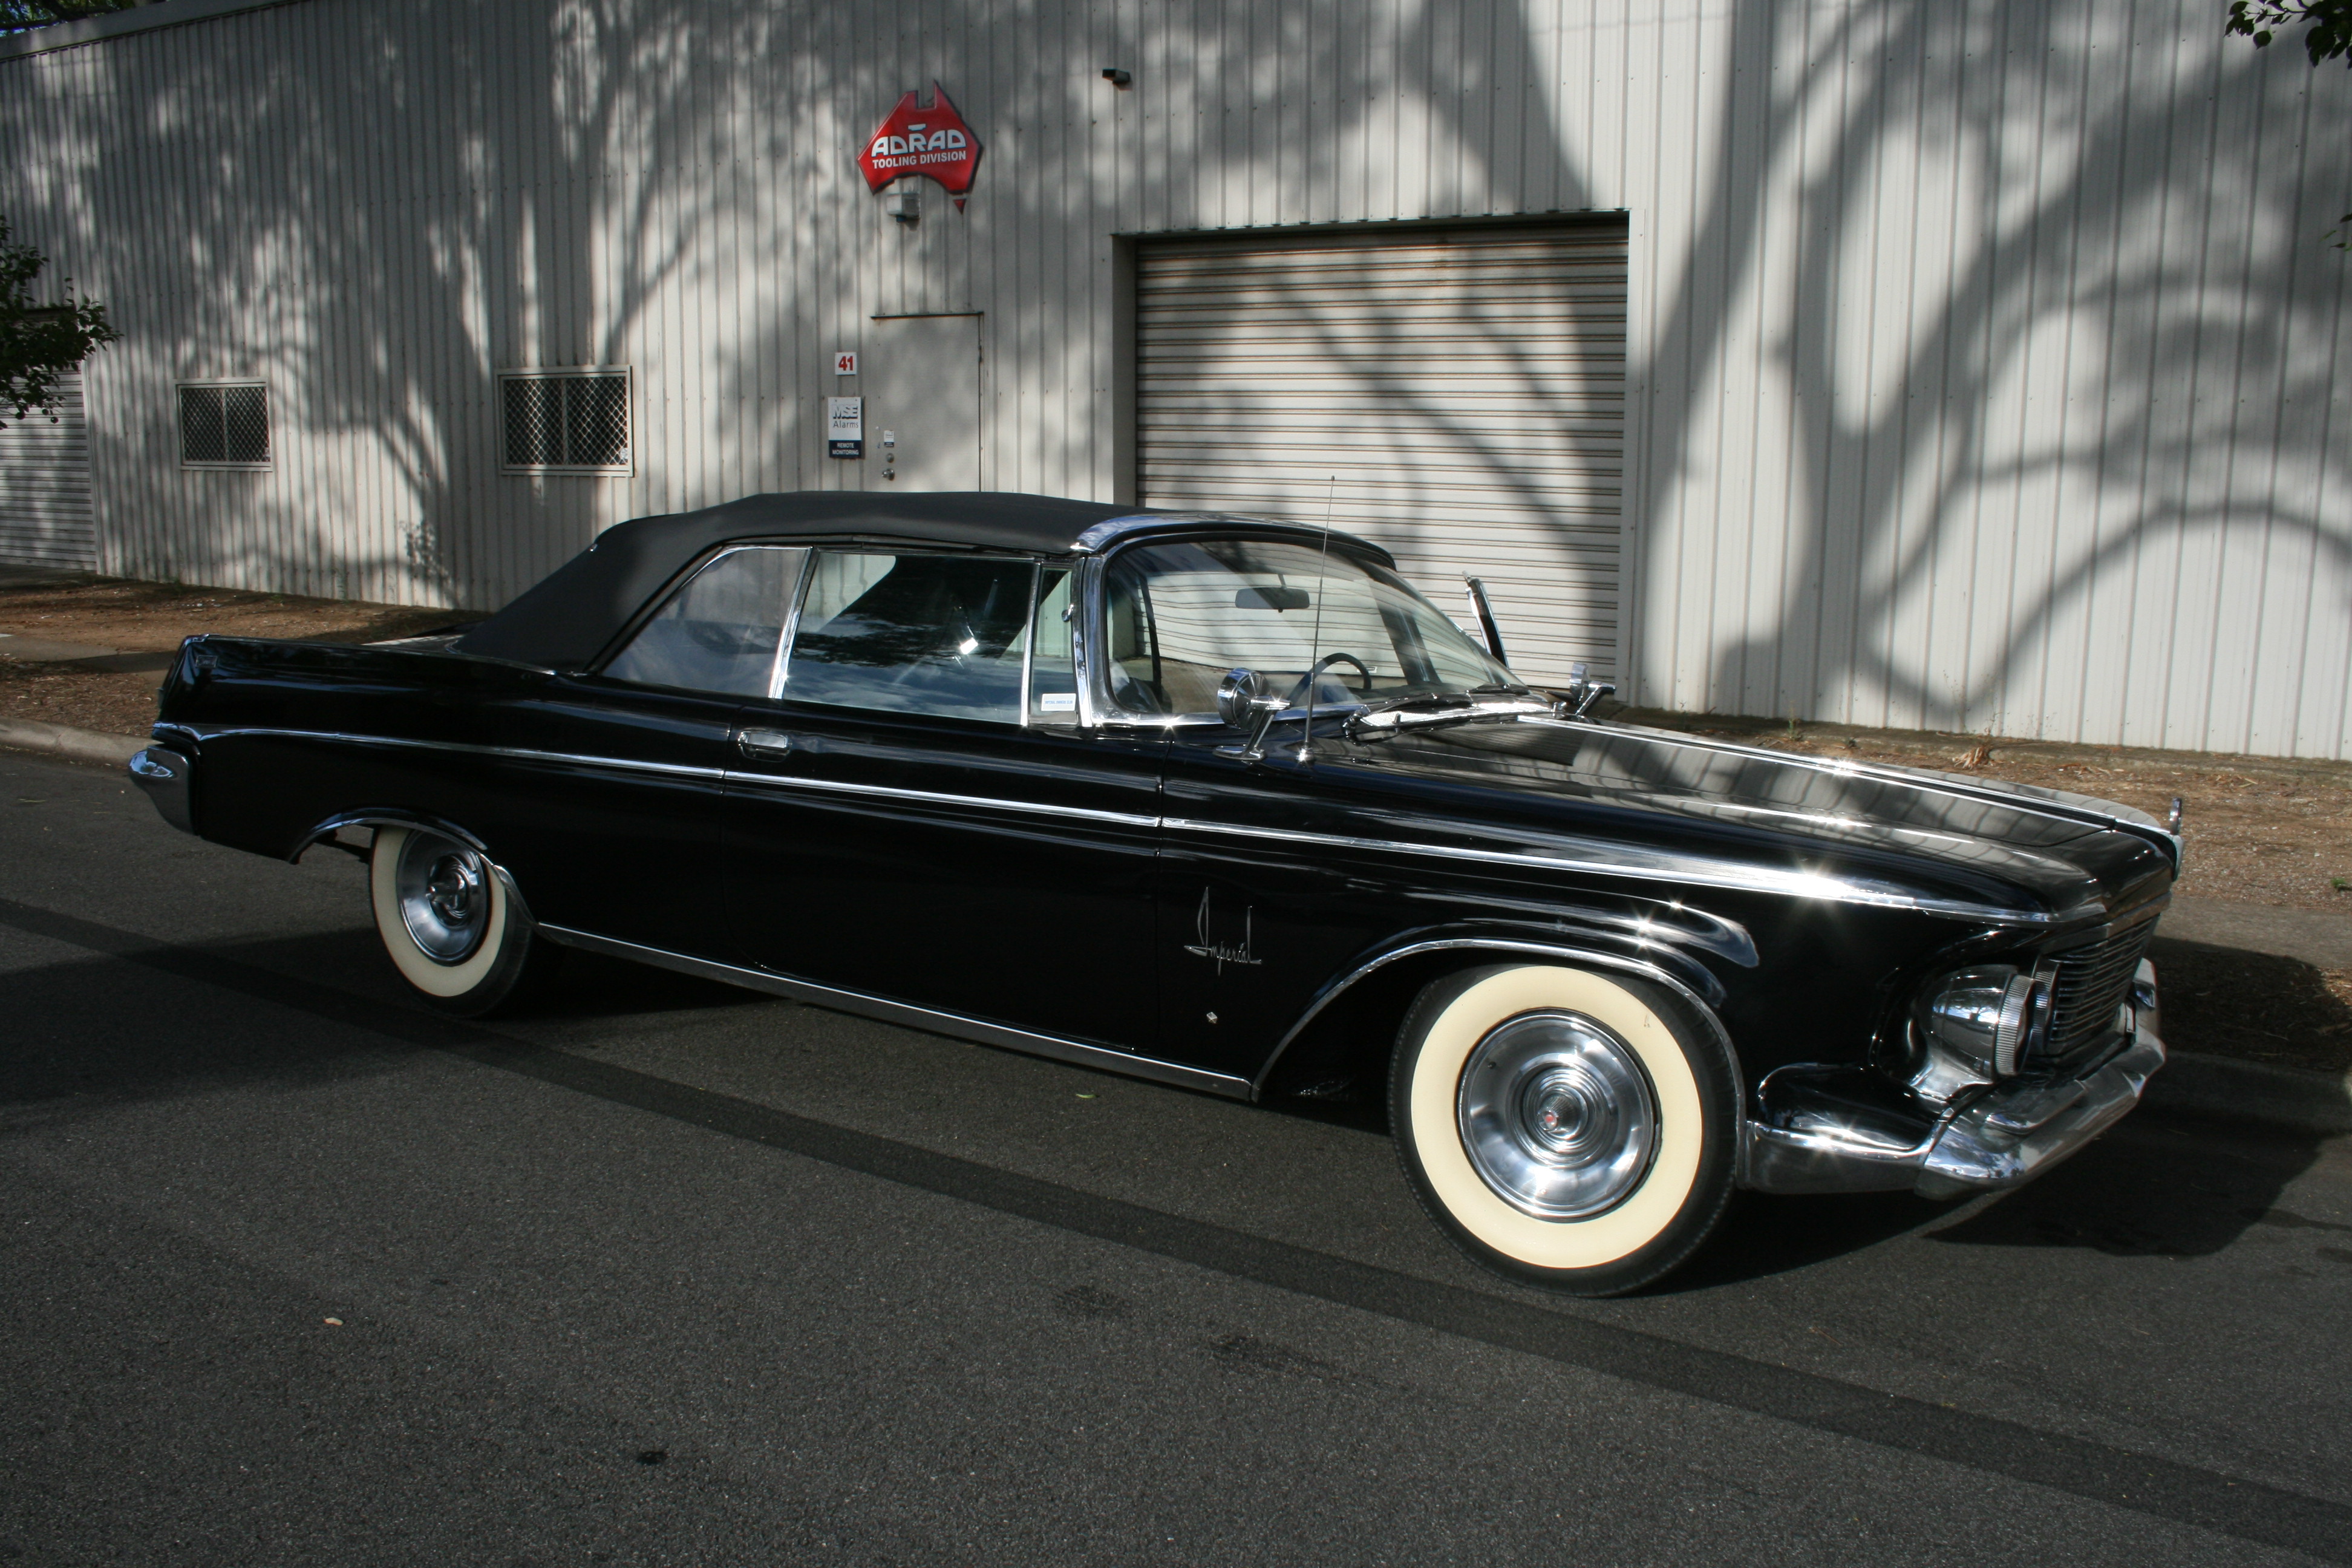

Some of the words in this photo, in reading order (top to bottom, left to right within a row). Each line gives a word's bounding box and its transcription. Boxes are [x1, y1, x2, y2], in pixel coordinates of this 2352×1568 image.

[871, 123, 966, 157] ADRAD
[872, 155, 917, 169] TOOLING
[920, 151, 966, 165] DIVISION
[838, 356, 854, 371] 41
[832, 406, 858, 419] MSE
[1184, 886, 1262, 976] Imperial
